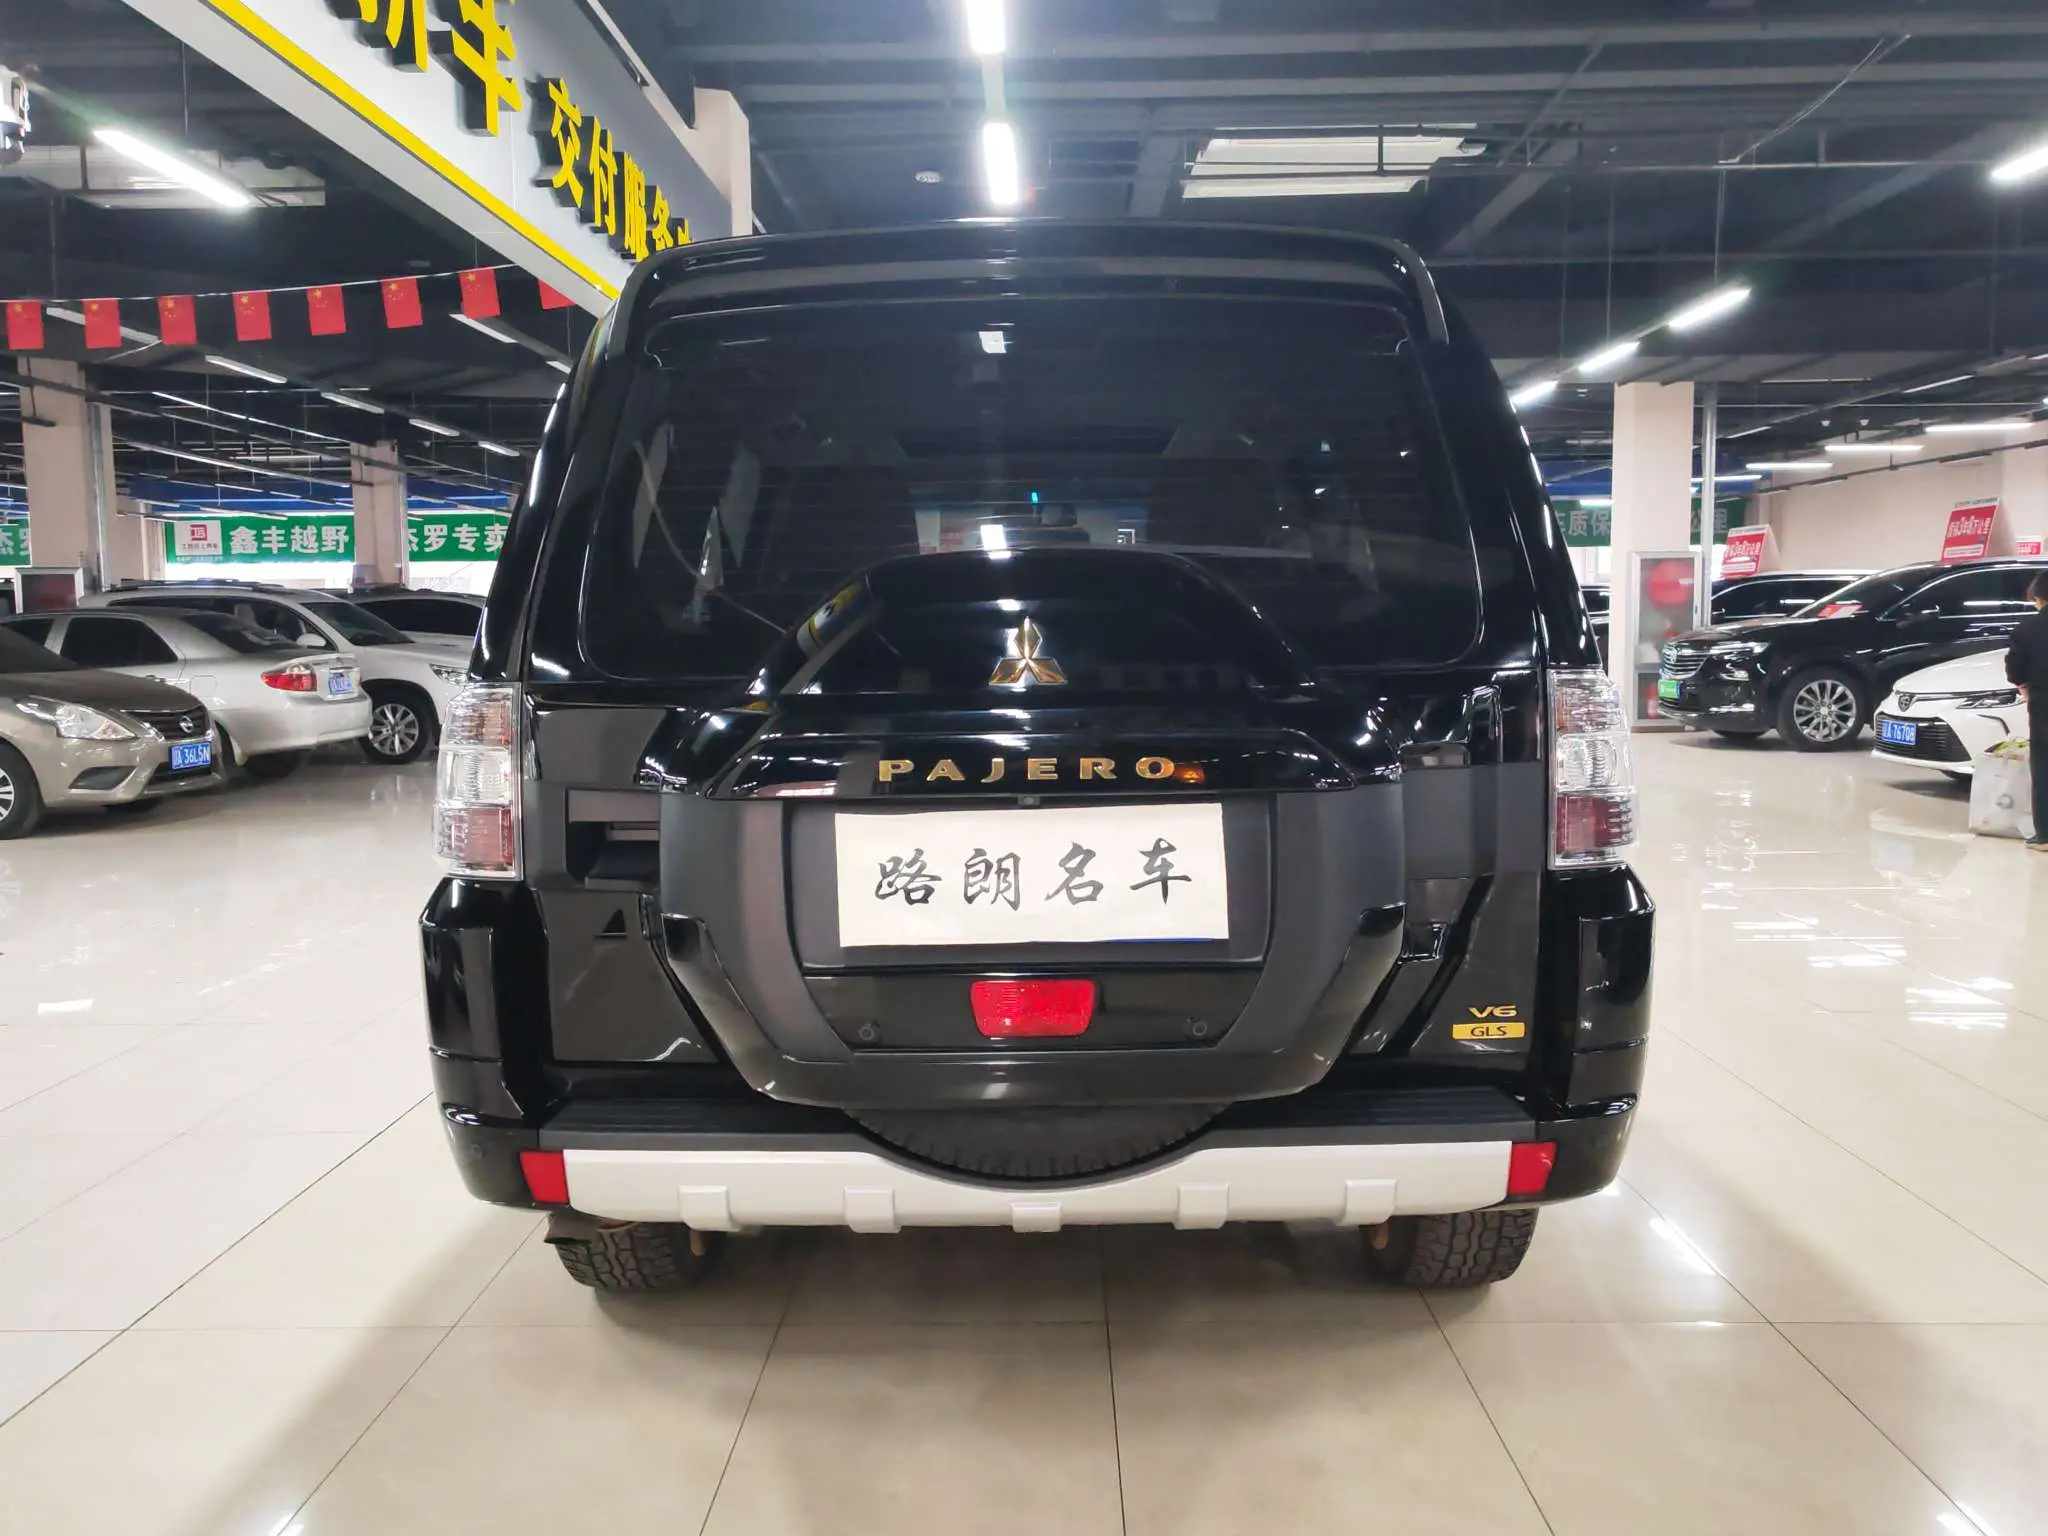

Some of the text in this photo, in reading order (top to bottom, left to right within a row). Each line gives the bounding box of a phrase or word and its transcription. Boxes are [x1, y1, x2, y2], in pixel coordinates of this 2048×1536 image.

[548, 77, 694, 262] 交付服务
[229, 525, 350, 555] 鑫丰越野
[878, 756, 1176, 783] PAJERO
[875, 837, 1192, 911] 路朗名车
[1468, 1005, 1518, 1018] V6
[1471, 1026, 1507, 1037] GLS
